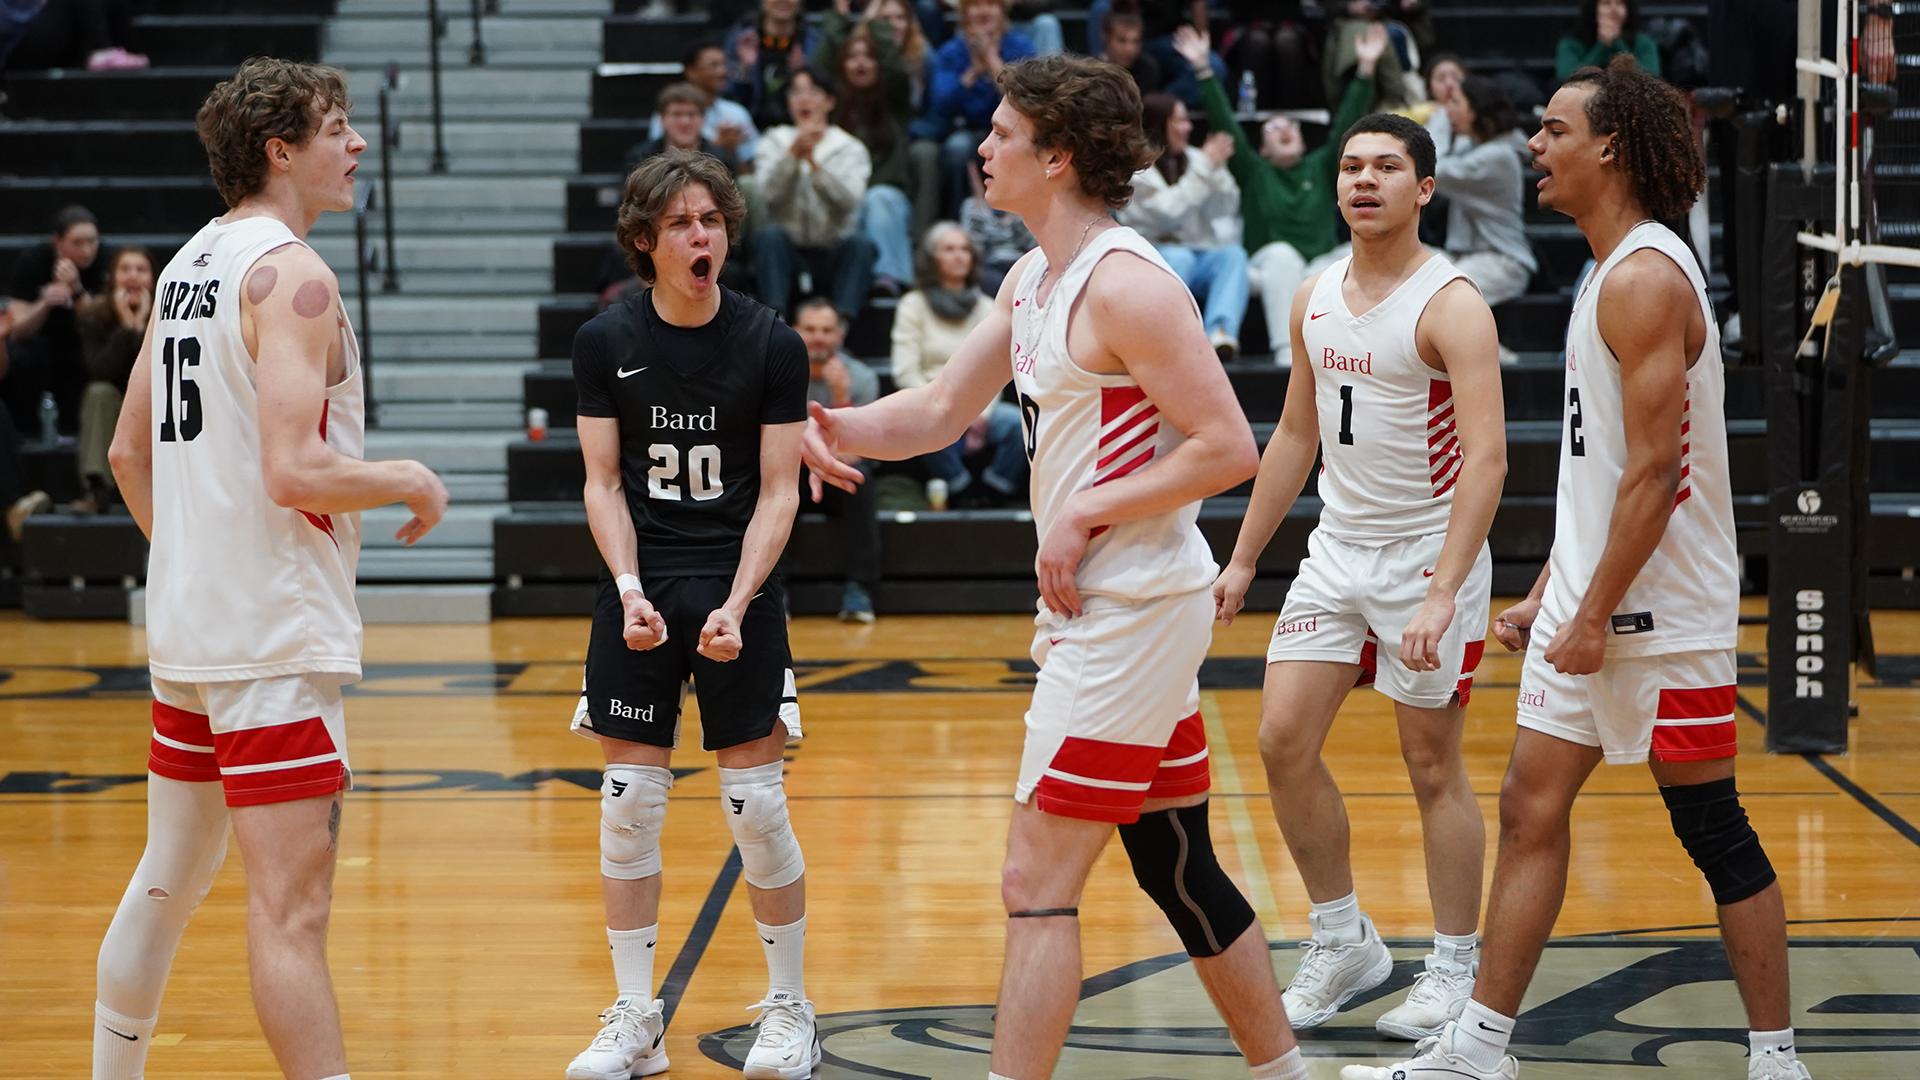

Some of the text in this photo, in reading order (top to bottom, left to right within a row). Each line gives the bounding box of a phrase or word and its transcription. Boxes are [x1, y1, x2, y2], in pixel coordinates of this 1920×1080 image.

[1323, 347, 1372, 375] Bard
[160, 337, 203, 442] 16
[650, 405, 717, 431] Bard
[1339, 385, 1354, 446] 1
[1570, 387, 1585, 457] 2
[648, 443, 724, 501] 20
[1277, 616, 1318, 636] Bard
[1640, 618, 1648, 627] L
[609, 698, 654, 723] Bard
[1519, 686, 1546, 708] ard
